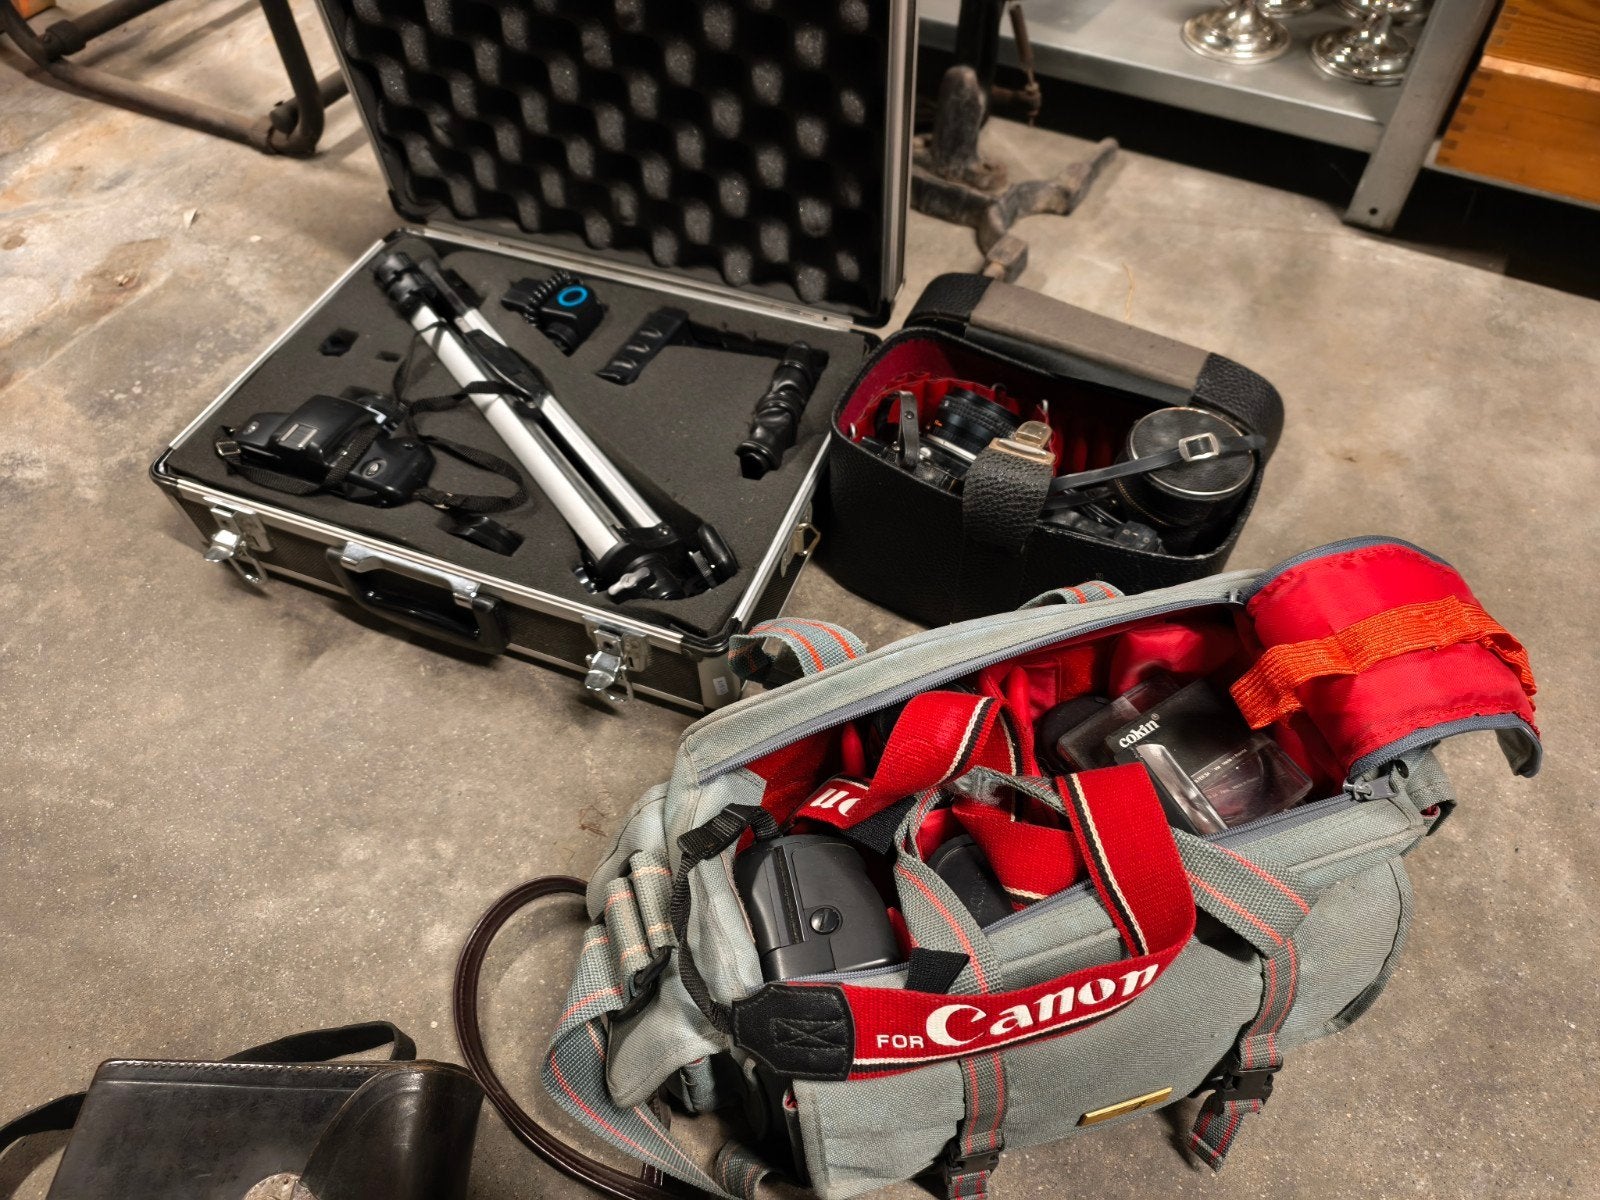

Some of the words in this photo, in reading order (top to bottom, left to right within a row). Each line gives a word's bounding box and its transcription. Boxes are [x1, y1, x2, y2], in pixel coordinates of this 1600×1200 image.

[1119, 720, 1160, 748] cokin
[877, 1034, 924, 1049] FOR
[925, 963, 1159, 1047] Canon
